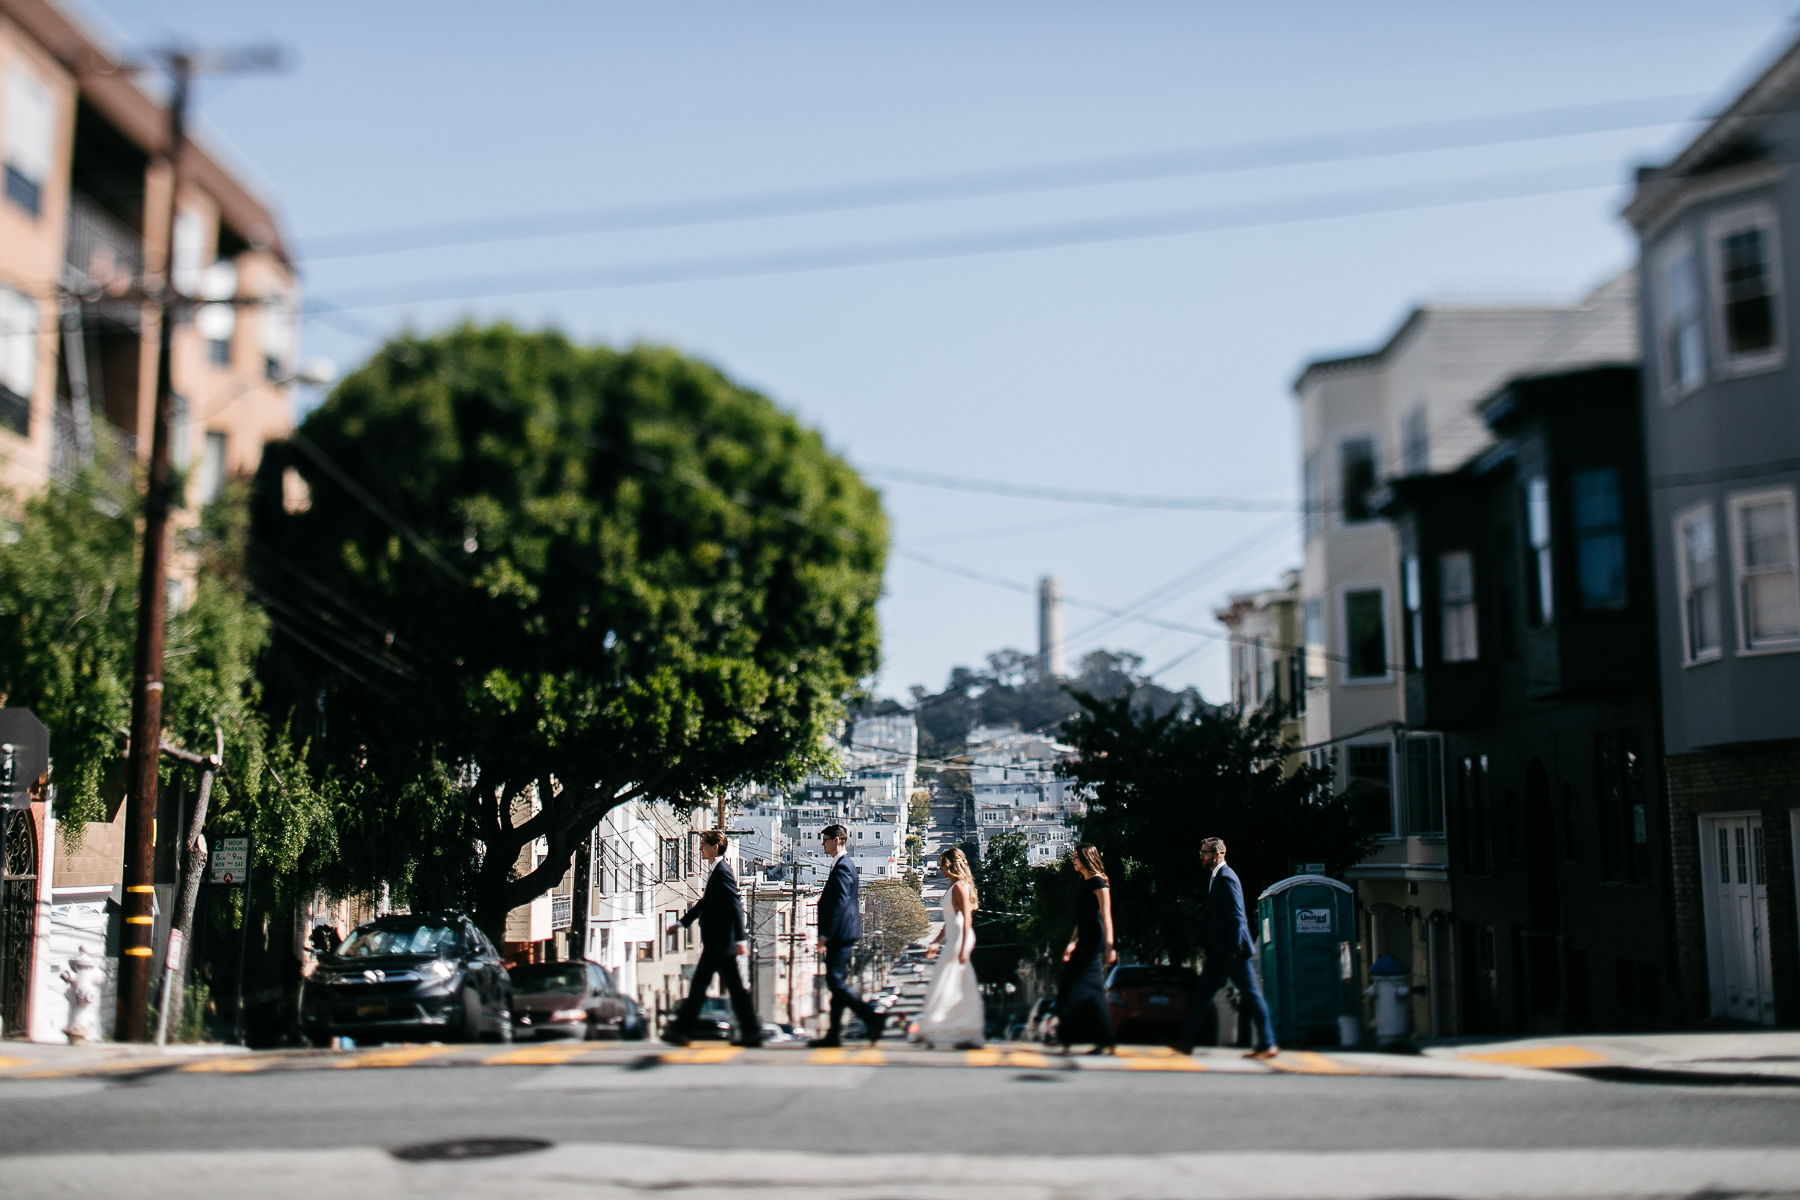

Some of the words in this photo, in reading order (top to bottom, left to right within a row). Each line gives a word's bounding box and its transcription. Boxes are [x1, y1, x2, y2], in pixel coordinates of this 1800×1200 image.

[215, 840, 222, 850] 2
[1296, 864, 1304, 874] 2
[1300, 913, 1327, 921] United
